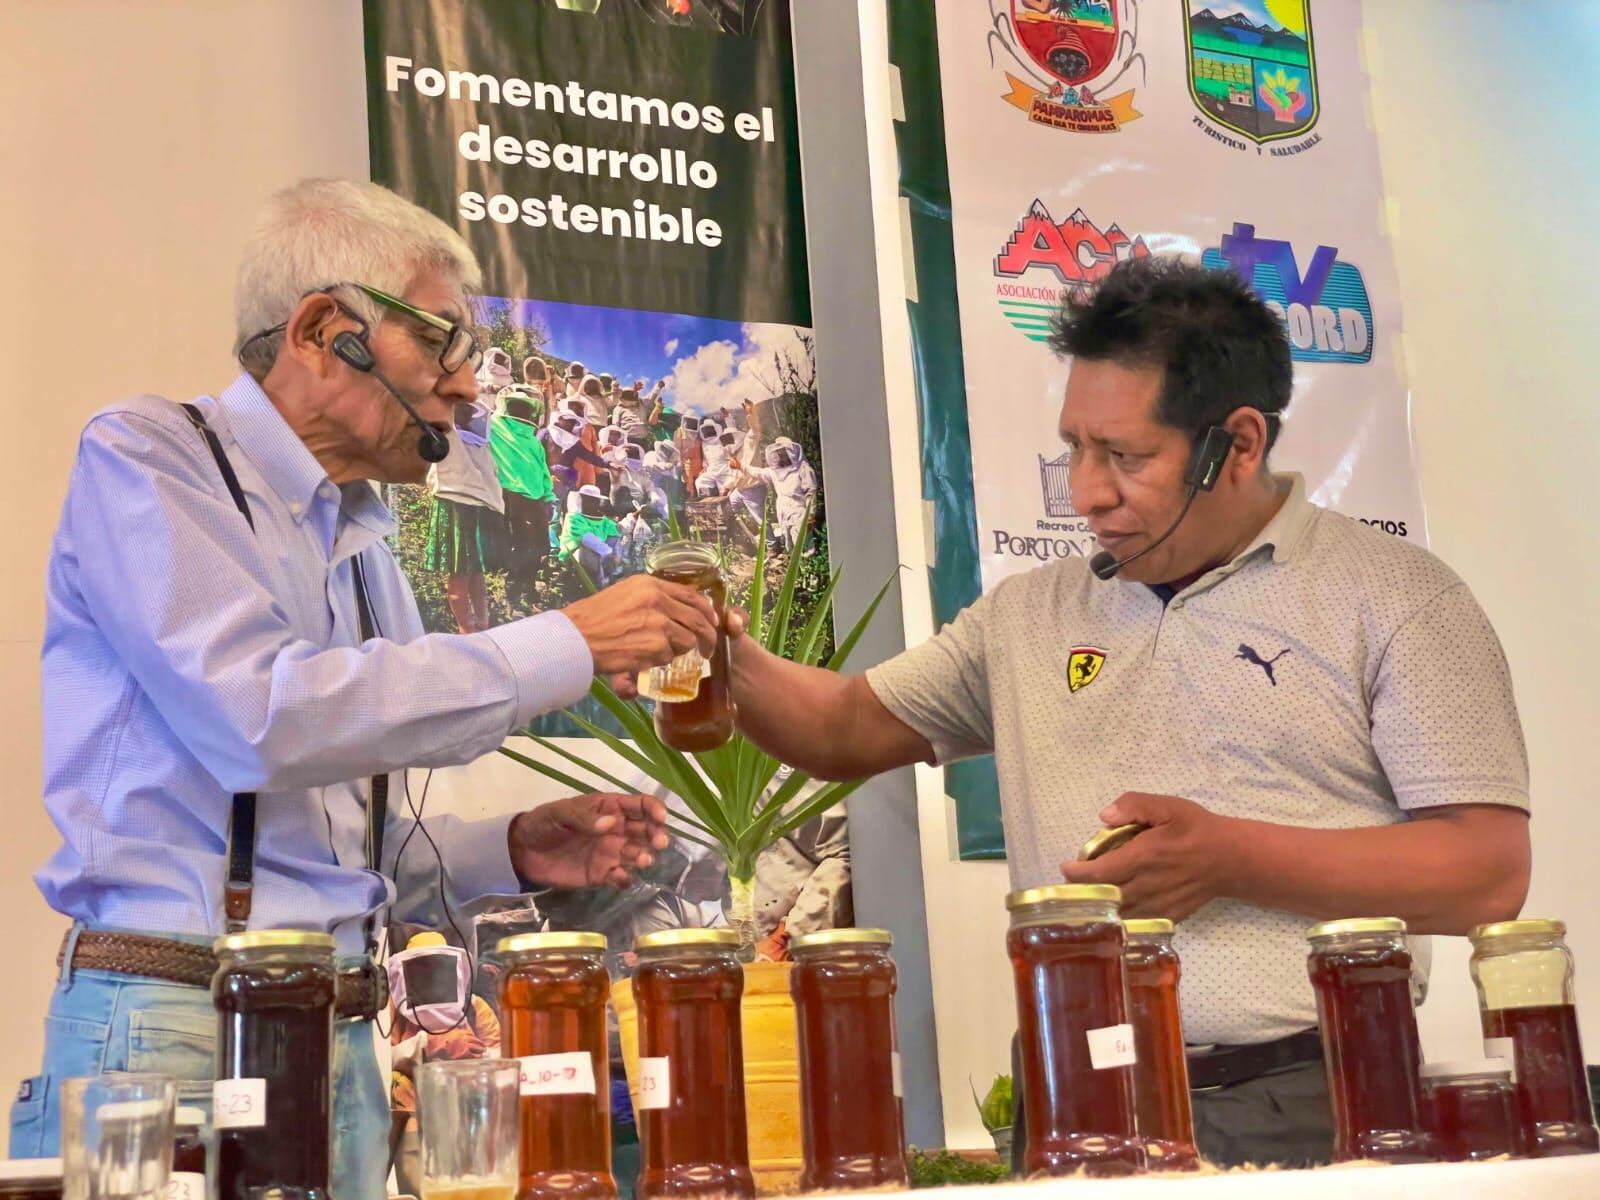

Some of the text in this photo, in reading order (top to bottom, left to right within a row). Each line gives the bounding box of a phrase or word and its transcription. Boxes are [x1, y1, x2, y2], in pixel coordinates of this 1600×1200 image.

[385, 56, 775, 142] Fomentamos el
[1032, 100, 1114, 122] PAMPAROMAS
[457, 125, 718, 189] desarrollo
[1192, 115, 1247, 152] TURISTICO
[1269, 132, 1323, 157] SALUDABLE
[458, 190, 722, 248] sostenible
[996, 283, 1056, 301] ASOCIACIÓN
[1036, 519, 1075, 532] Recreo
